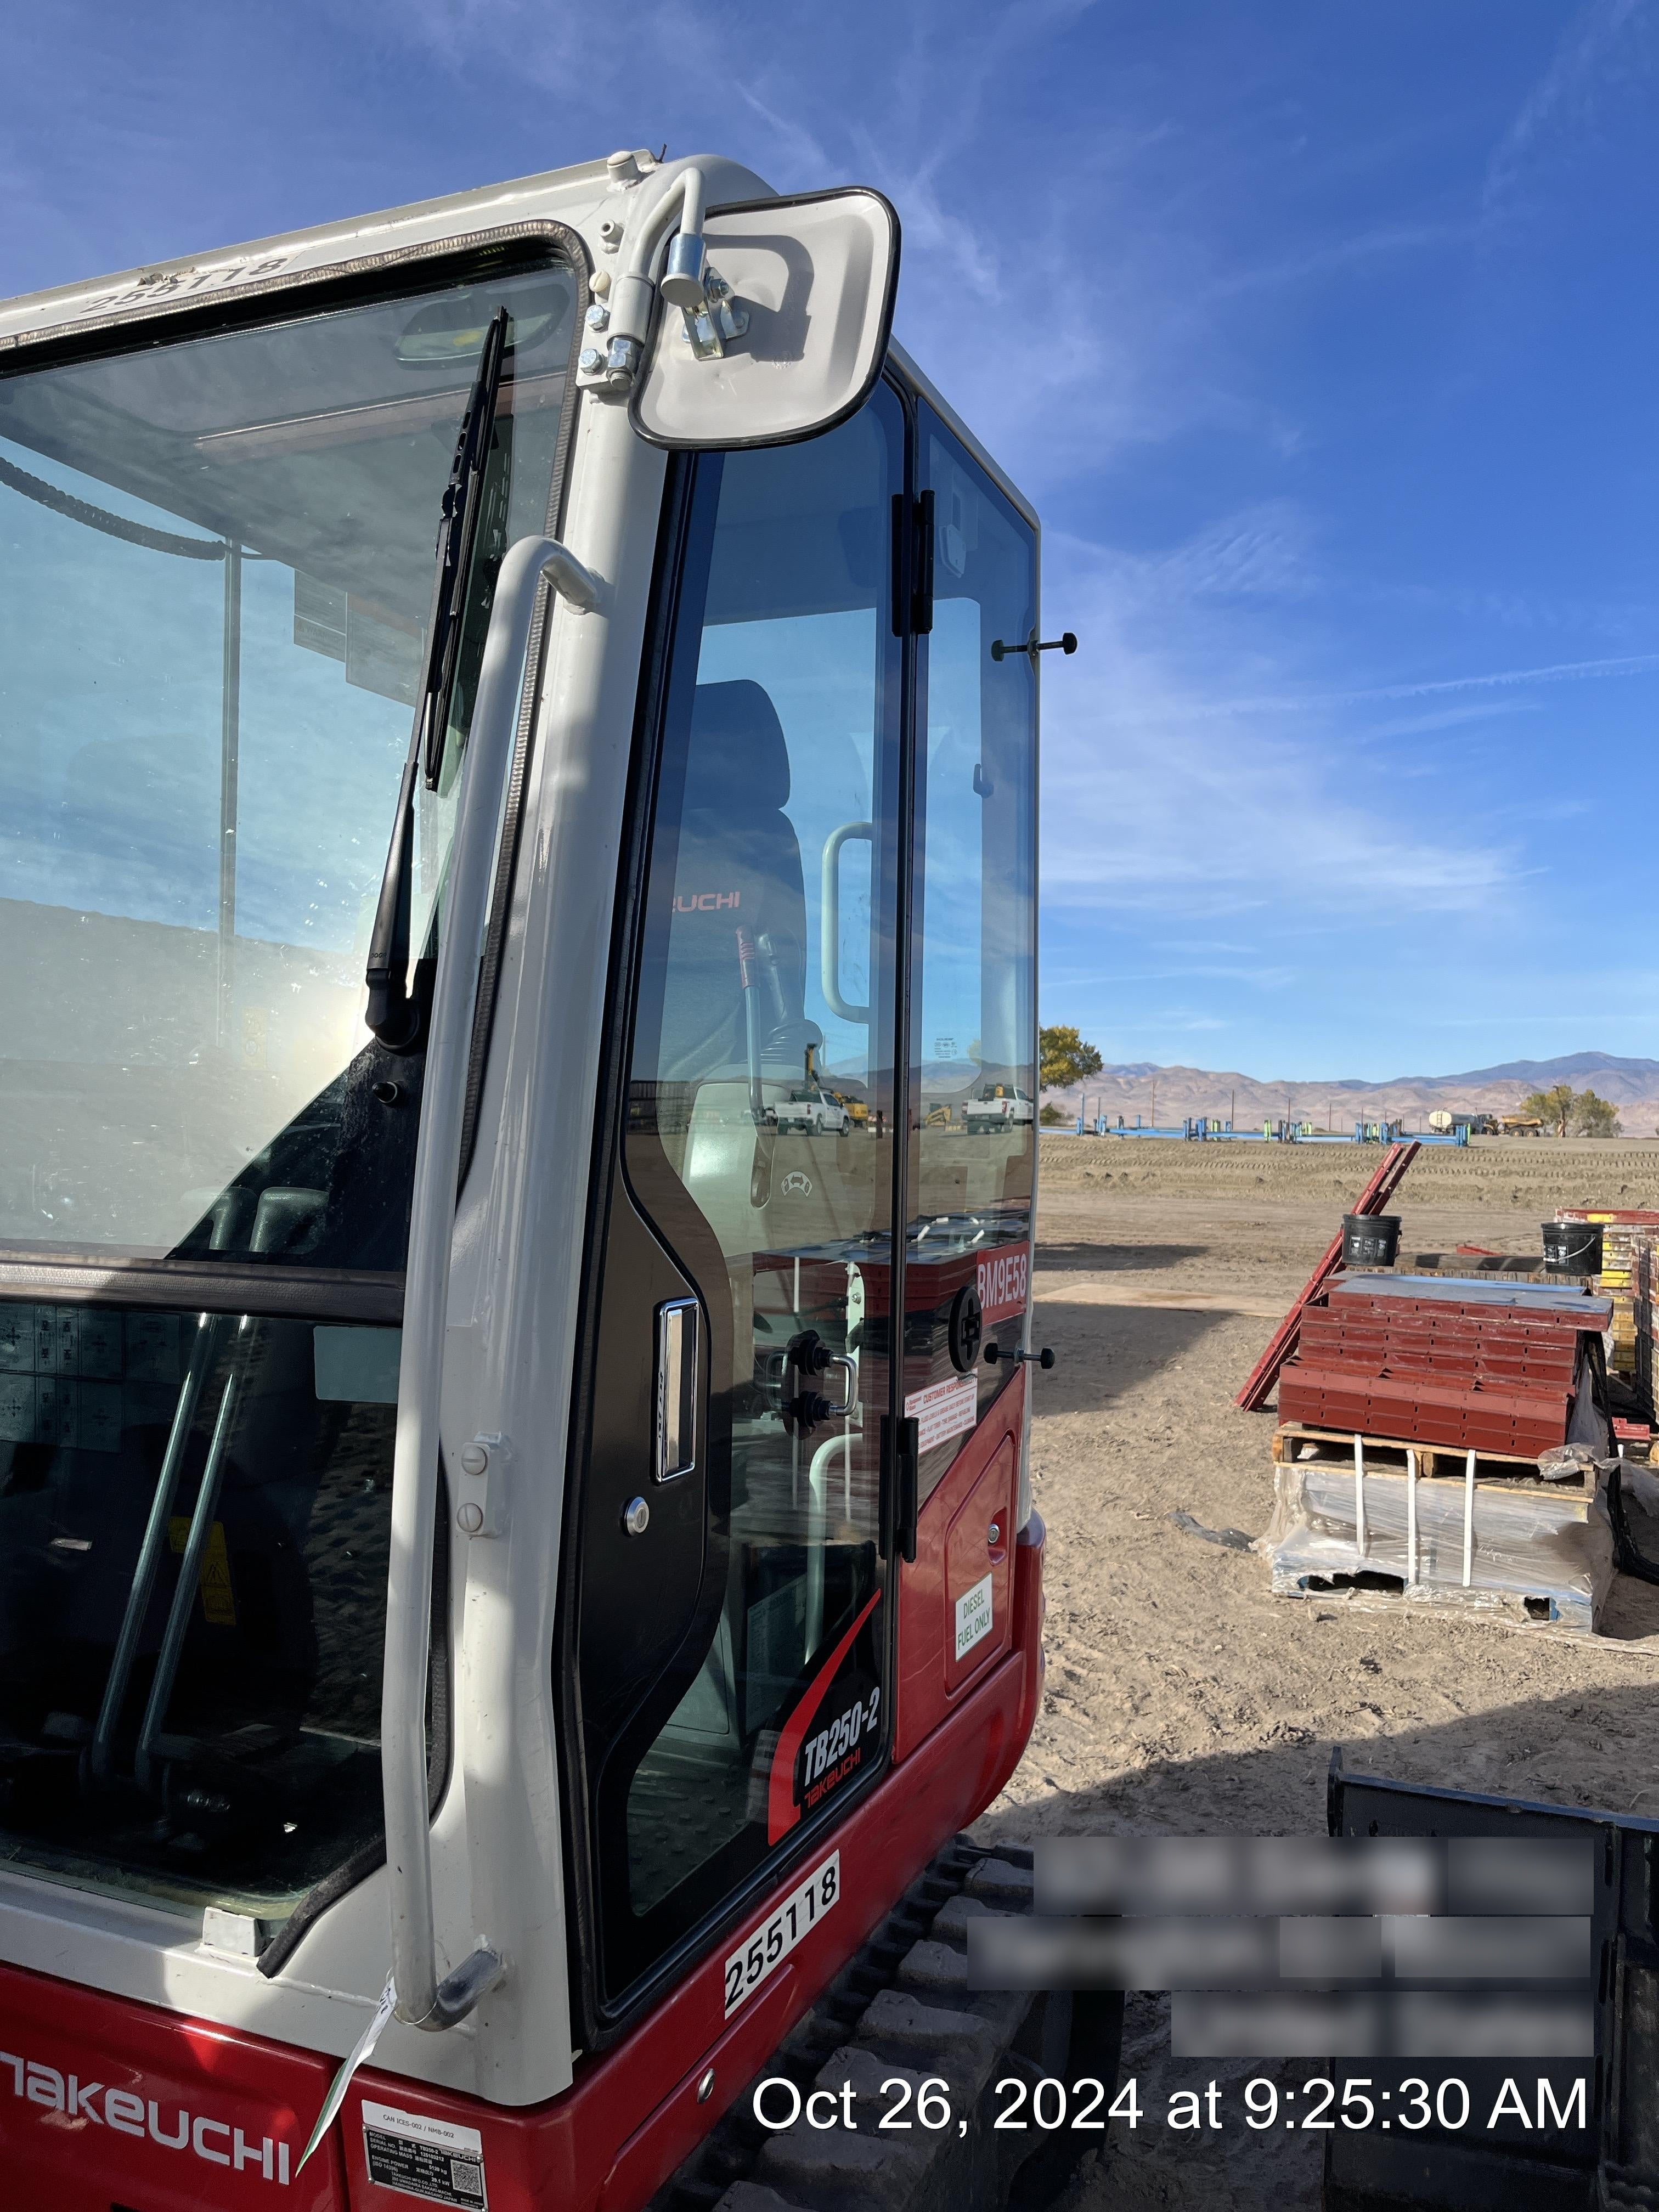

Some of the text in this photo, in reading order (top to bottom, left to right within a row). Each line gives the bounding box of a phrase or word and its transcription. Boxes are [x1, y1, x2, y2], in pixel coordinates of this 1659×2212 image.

[80, 257, 287, 313] 255118
[673, 891, 740, 912] UCHI
[978, 1253, 1026, 1310] BM9E58
[923, 1386, 945, 1404] CUSTOMER
[963, 1589, 984, 1619] DIESEL
[958, 1607, 990, 1650] FUEL ONLY
[805, 1686, 879, 1786] TB250-2
[725, 1866, 836, 2010] 255118
[383, 2114, 395, 2123] CAN
[397, 2118, 422, 2130] ICES-002
[428, 2126, 454, 2138] NMB-002
